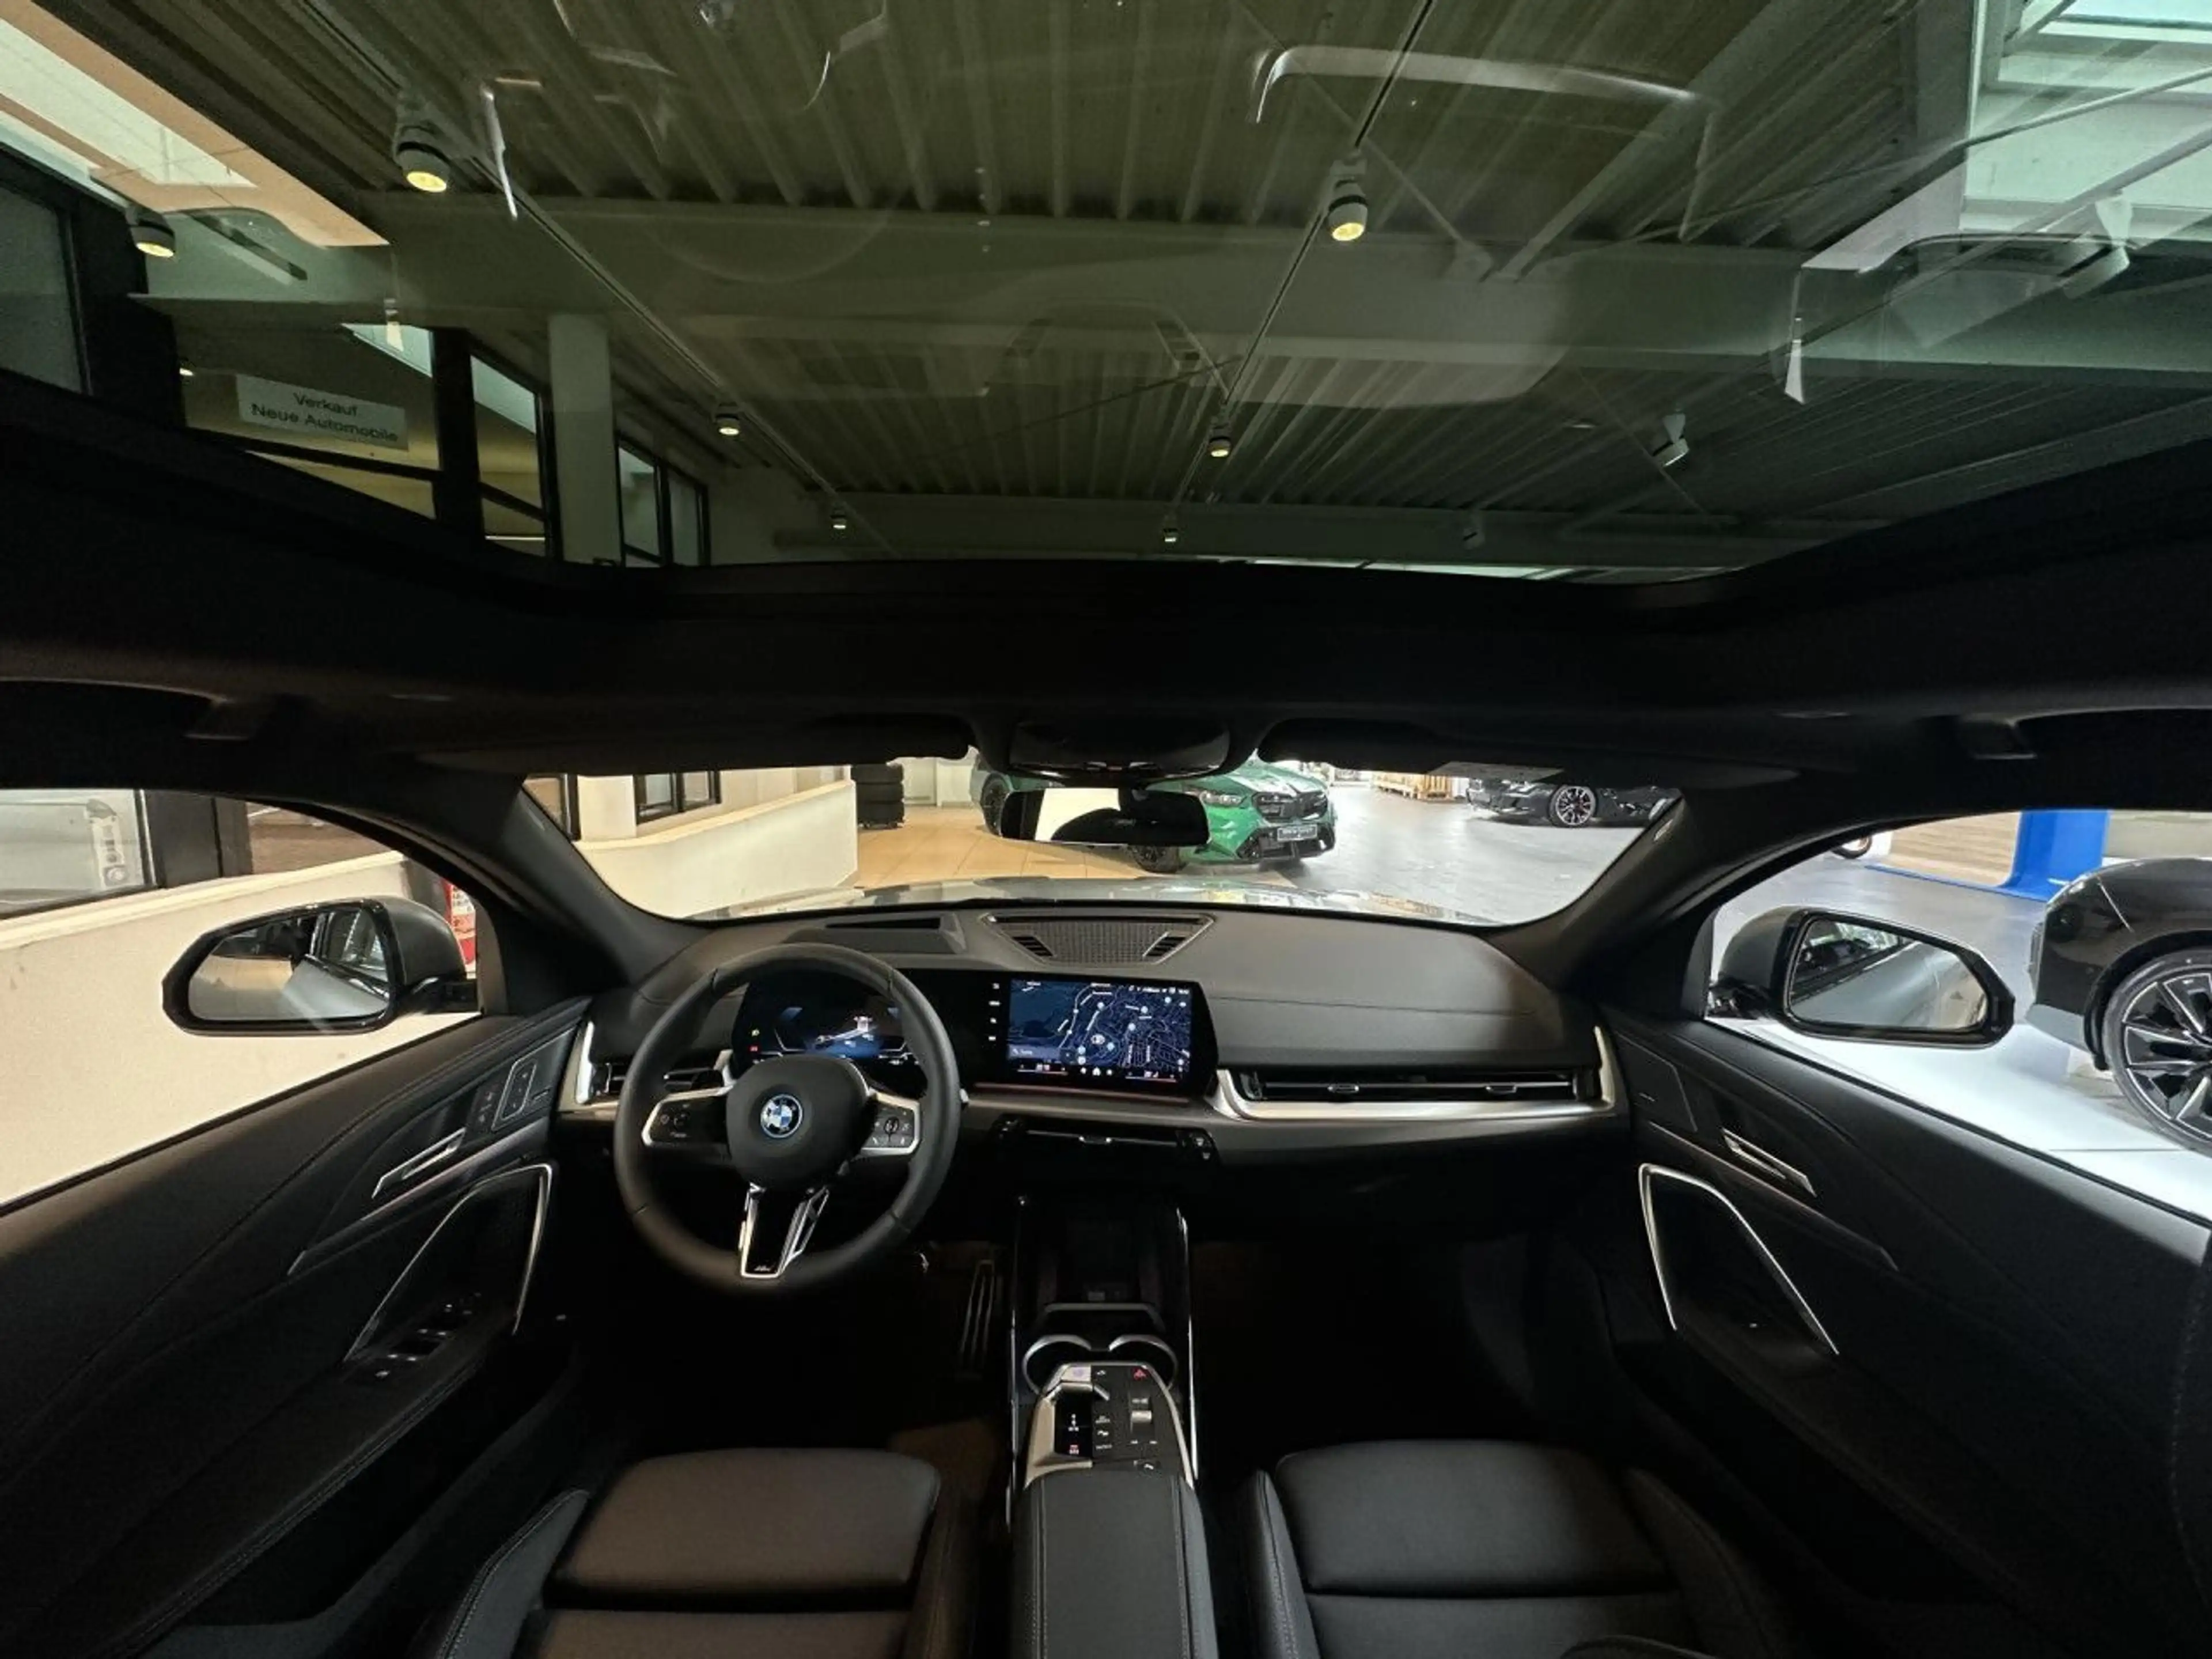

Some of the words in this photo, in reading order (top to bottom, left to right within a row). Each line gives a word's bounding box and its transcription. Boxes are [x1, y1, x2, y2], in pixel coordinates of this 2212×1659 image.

[293, 392, 358, 417] Verkauf
[251, 403, 299, 423] Neue
[305, 414, 399, 442] Automobile
